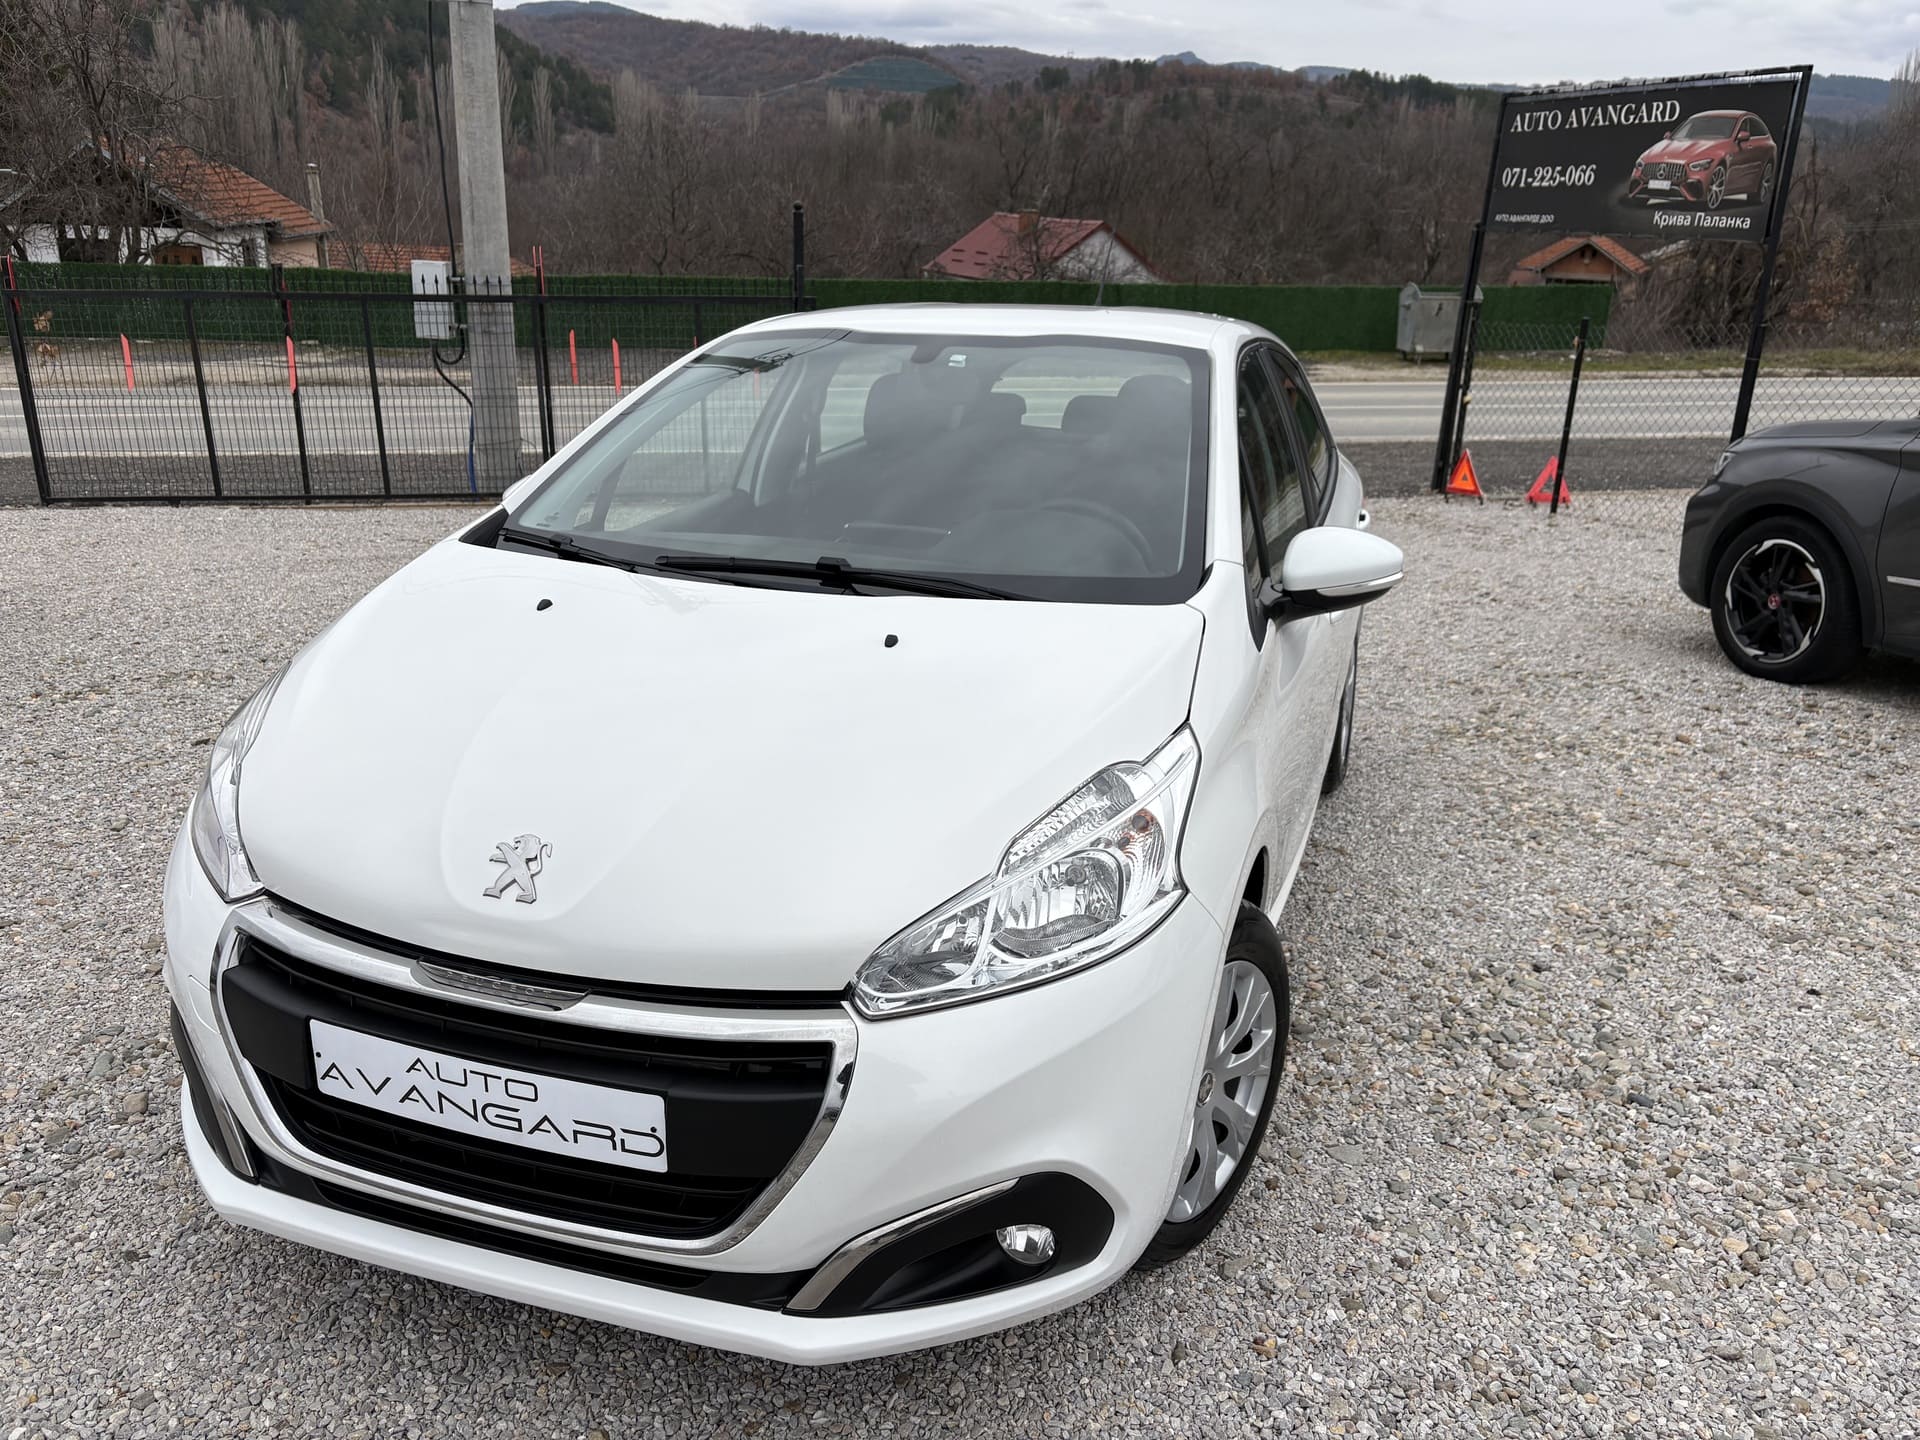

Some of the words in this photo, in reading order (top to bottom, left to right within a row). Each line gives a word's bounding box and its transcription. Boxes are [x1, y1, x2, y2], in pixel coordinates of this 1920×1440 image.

[1511, 109, 1561, 133] AUTO
[1565, 100, 1681, 129] AVANGARD
[1502, 164, 1597, 188] 071-225-066
[1653, 210, 1691, 229] Крива
[1694, 212, 1751, 229] Паланка
[446, 971, 552, 998] PEUGEOT
[405, 1057, 539, 1103] AUTO
[320, 1062, 665, 1158] AVANGARD
